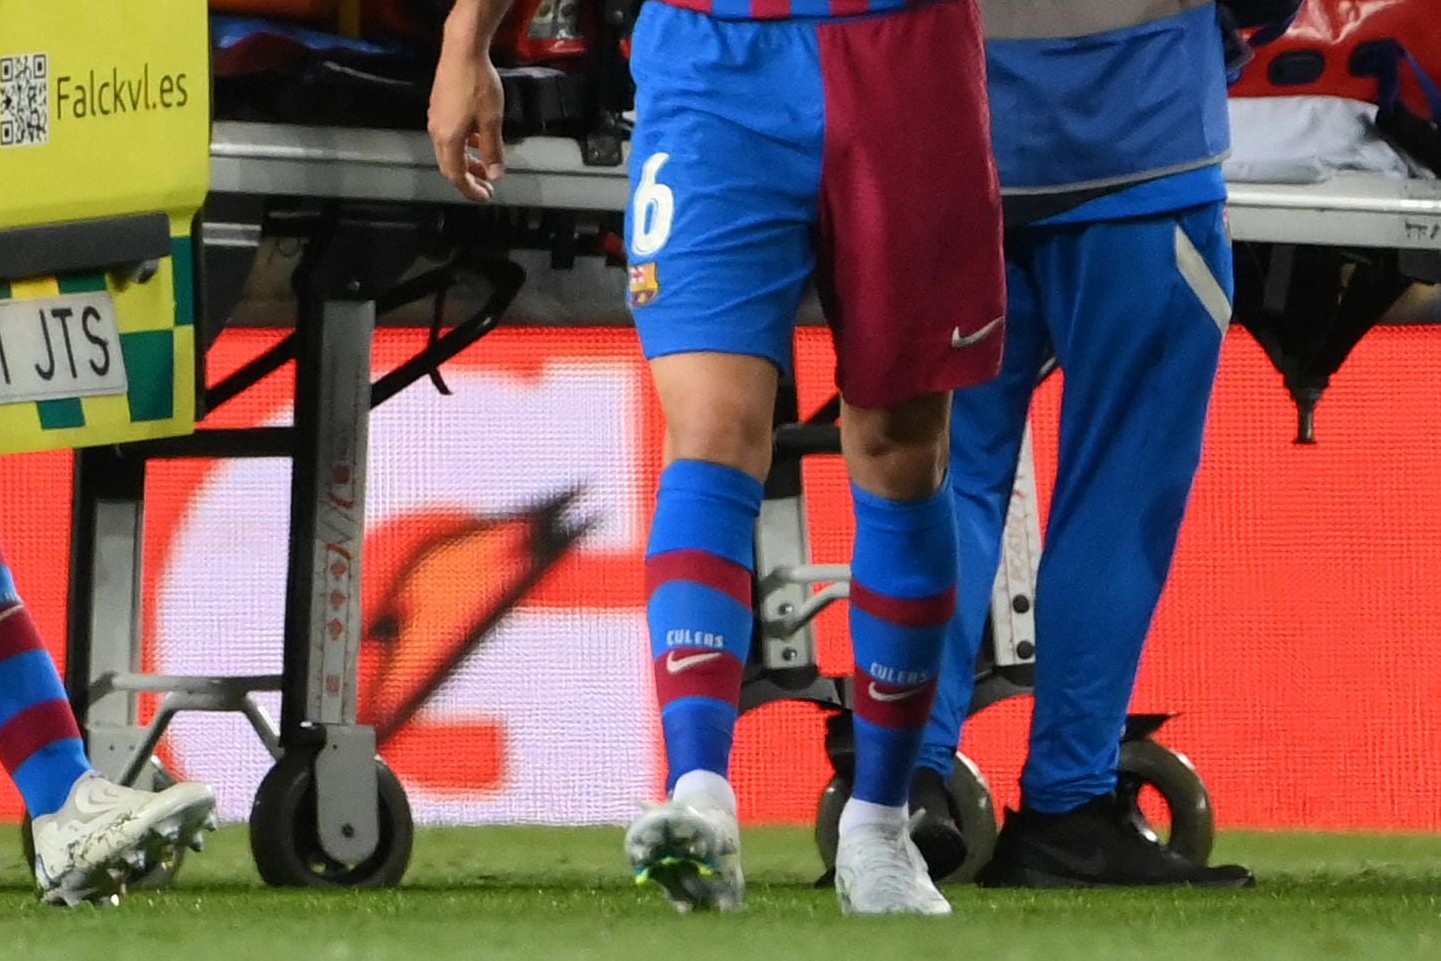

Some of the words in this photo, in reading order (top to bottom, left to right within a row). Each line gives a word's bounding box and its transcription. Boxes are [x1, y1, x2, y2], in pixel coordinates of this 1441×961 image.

[57, 62, 188, 120] Falckvl.es
[632, 152, 674, 256] 6
[35, 305, 110, 380] JTS
[666, 628, 724, 648] CULERS
